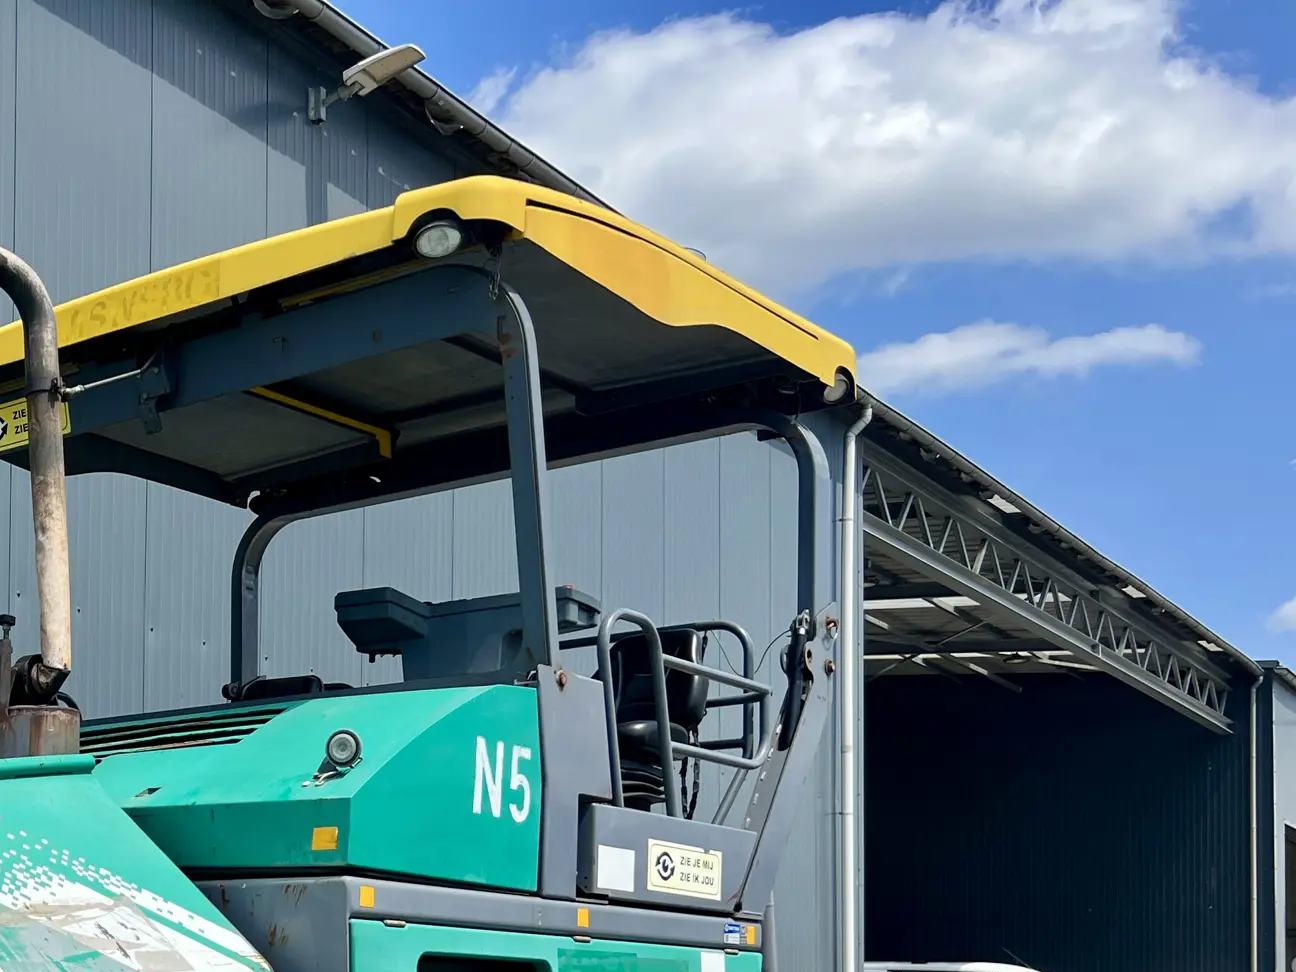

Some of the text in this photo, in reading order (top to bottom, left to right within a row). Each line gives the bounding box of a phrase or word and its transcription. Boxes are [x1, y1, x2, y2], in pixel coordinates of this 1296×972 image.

[12, 409, 27, 420] ZIE
[14, 424, 29, 434] ZIE
[472, 734, 532, 823] N5
[680, 856, 713, 870] ZIE JE MIJ
[680, 871, 714, 886] ZIE IK JOU
